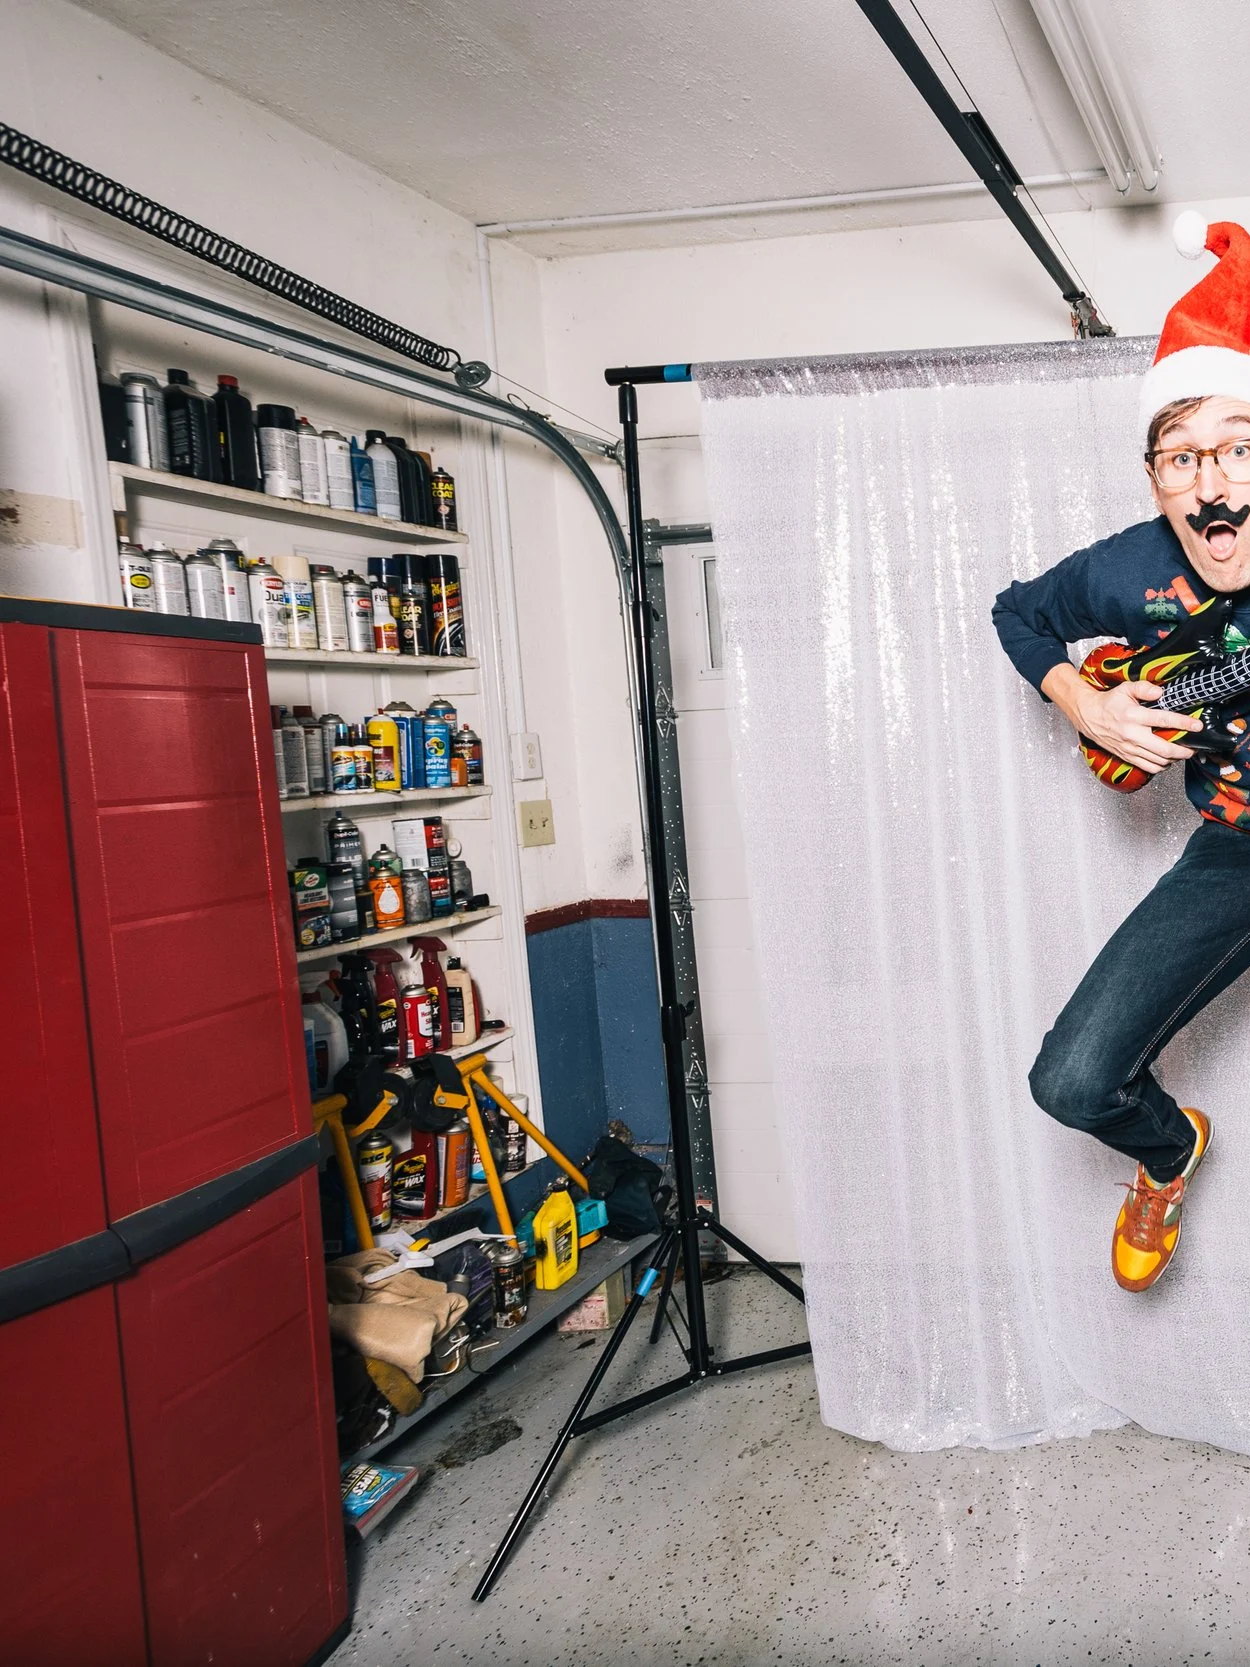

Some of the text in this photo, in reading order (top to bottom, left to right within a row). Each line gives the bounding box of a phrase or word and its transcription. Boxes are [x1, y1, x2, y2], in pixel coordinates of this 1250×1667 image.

[432, 490, 453, 499] COAT
[381, 1019, 397, 1033] WAX
[404, 1175, 426, 1188] WAX
[352, 1468, 381, 1497] WIPES
